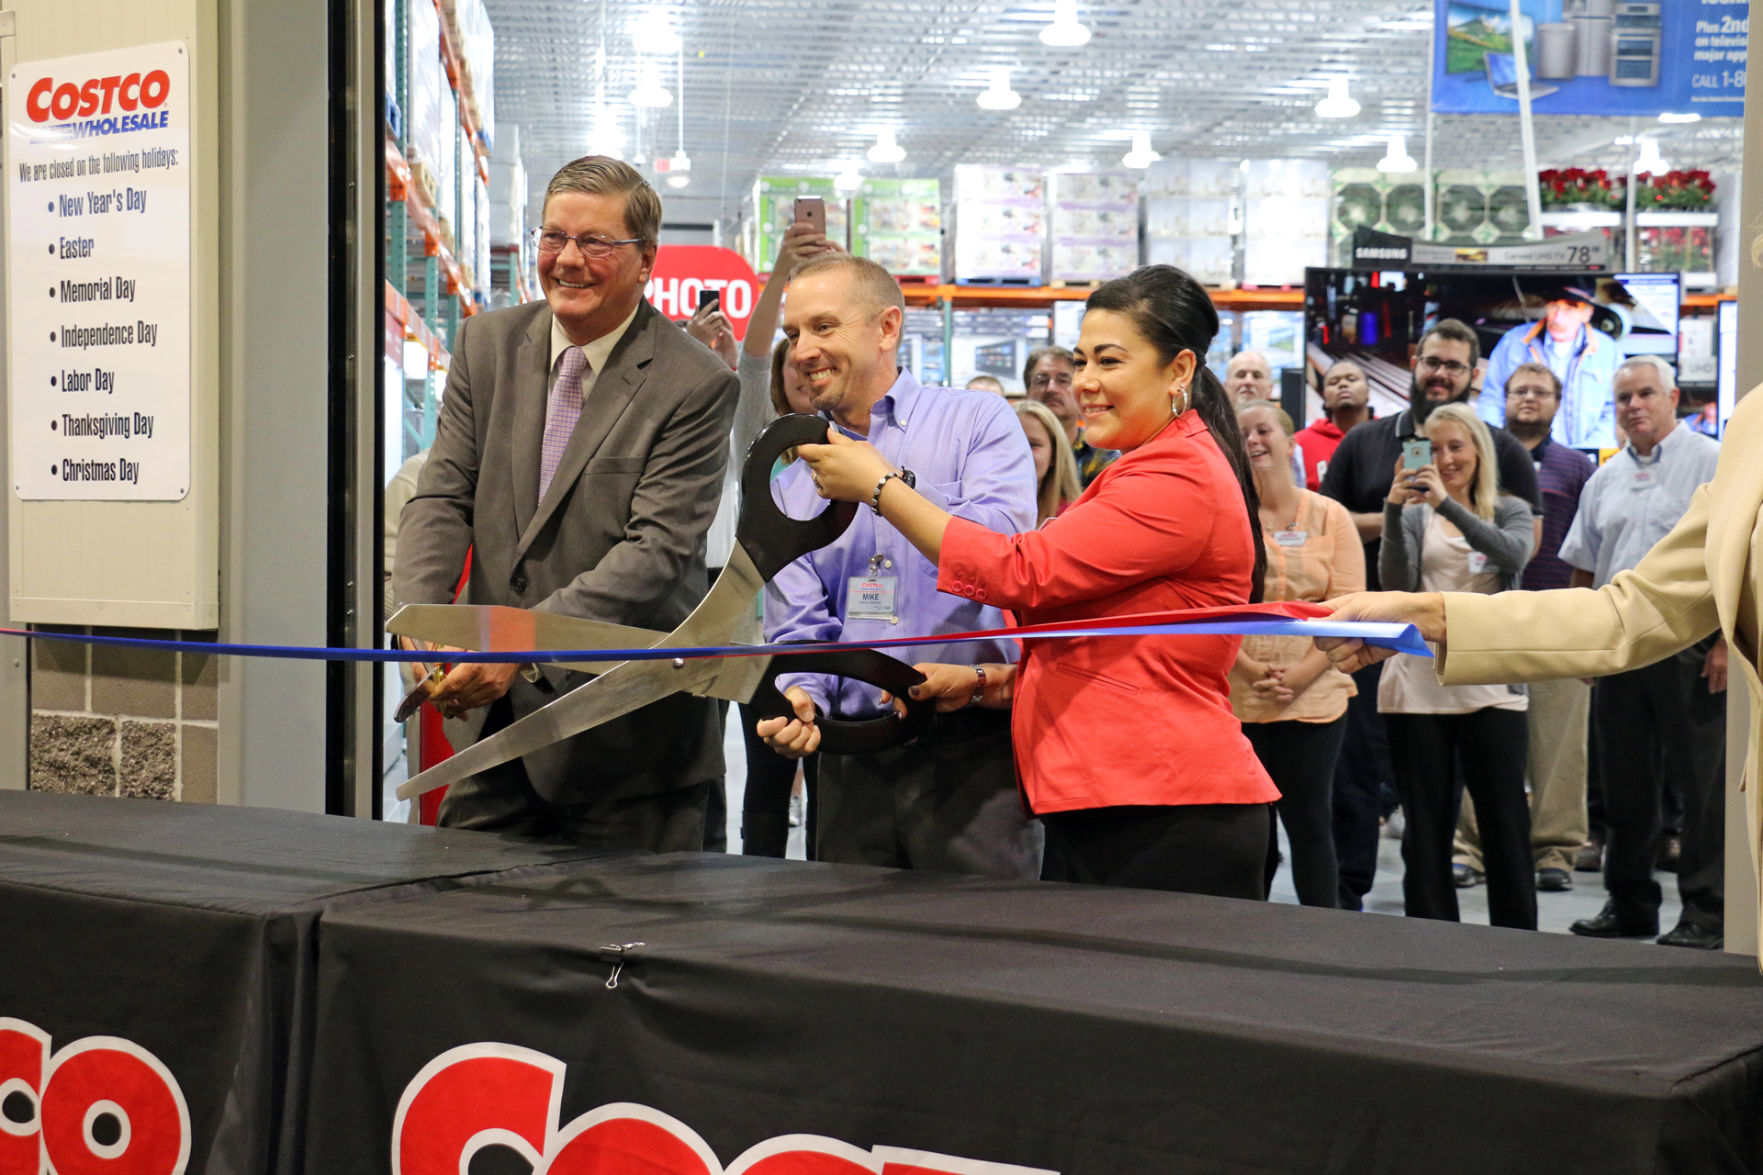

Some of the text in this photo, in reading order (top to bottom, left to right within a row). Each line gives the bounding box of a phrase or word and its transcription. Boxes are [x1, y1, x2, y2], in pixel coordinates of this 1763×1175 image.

[1692, 74, 1718, 88] CALL
[26, 69, 171, 123] COSTCO
[72, 110, 169, 139] WHOLESALE
[20, 147, 178, 182] We are closed on the following holidays:
[59, 187, 147, 217] New Year's Day
[60, 236, 94, 259] Easter
[1356, 248, 1407, 260] SAMSUNG
[60, 276, 135, 303] Memorial Day
[61, 320, 158, 351] Independence Day
[62, 368, 115, 394] Labor Day
[62, 412, 154, 439] Thanksgiving Day
[62, 458, 140, 485] Christmas Day
[862, 593, 880, 601] MIKE
